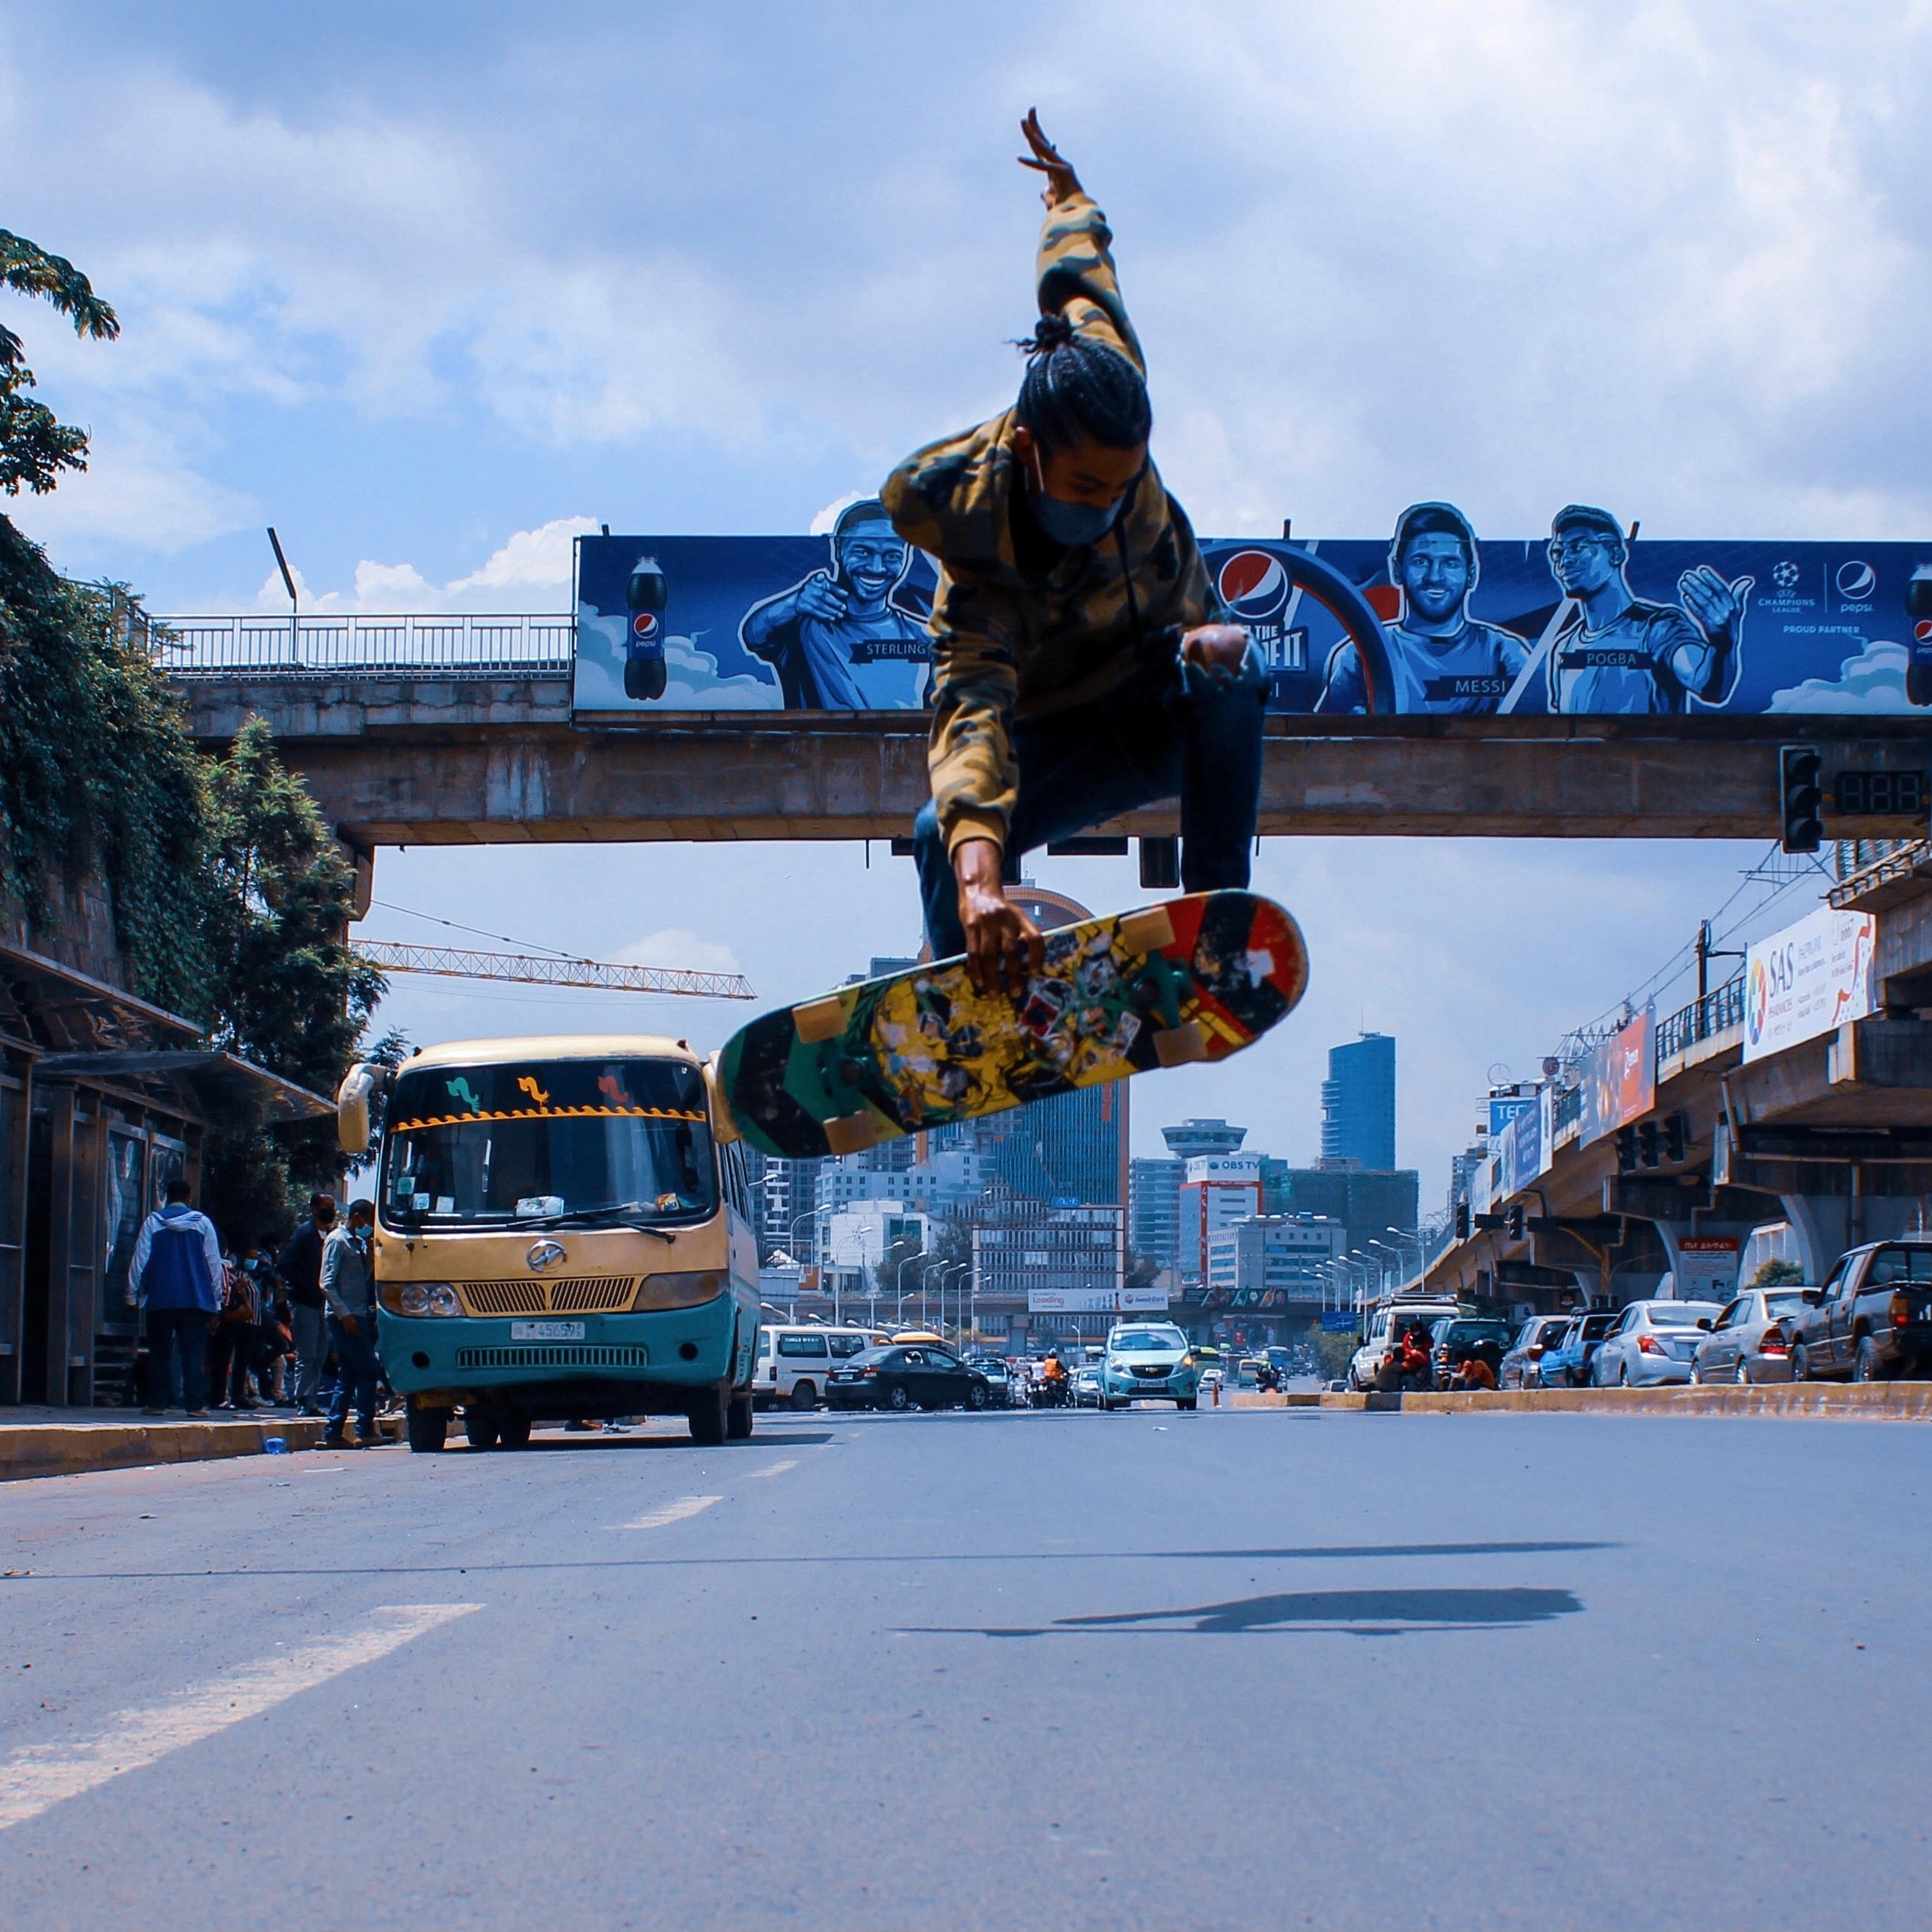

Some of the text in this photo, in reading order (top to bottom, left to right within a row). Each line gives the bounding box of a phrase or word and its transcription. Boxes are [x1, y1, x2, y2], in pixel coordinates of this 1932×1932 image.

[1758, 597, 1815, 607] CHAMPIONS
[1841, 604, 1874, 614] pepsi
[1255, 625, 1278, 640] THE
[1783, 625, 1860, 634] PROUD PARTNER
[867, 643, 926, 656] STERLING
[1284, 631, 1303, 666] IT
[1587, 653, 1637, 665] POGBA
[1455, 680, 1506, 693] MESSI
[1769, 941, 1794, 998] SAS
[1222, 1160, 1261, 1169] OBS TV
